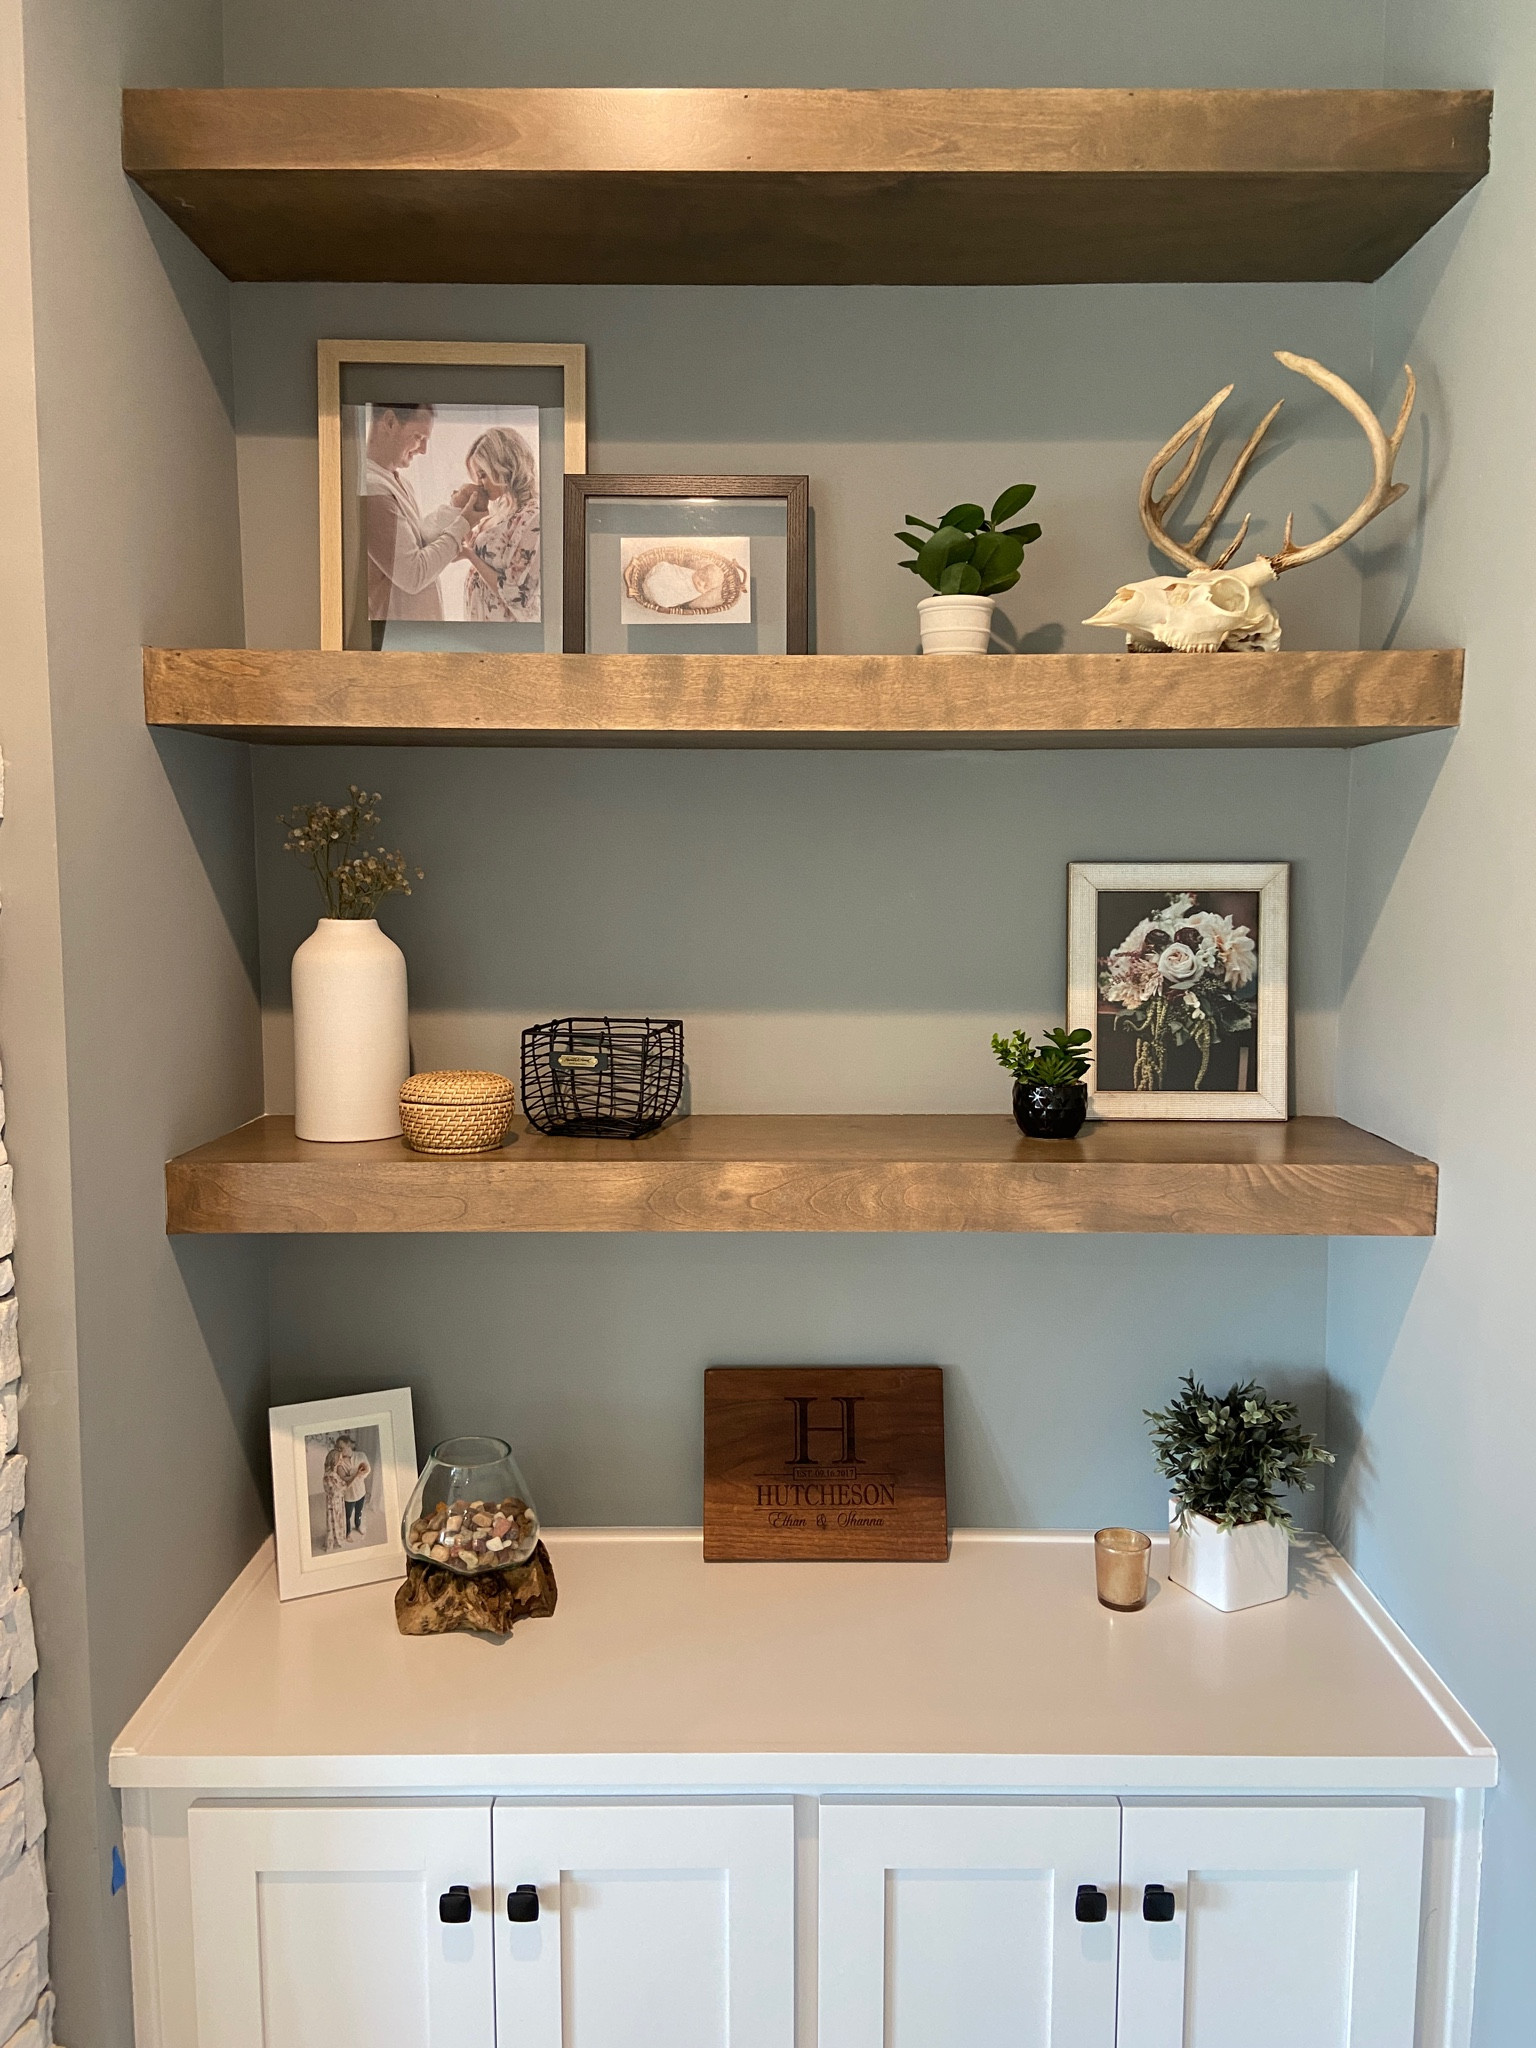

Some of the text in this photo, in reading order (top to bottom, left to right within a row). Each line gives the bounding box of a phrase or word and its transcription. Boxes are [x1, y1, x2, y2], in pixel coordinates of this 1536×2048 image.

[784, 1396, 866, 1464] H
[756, 1483, 895, 1506] HUTCHESON
[768, 1510, 885, 1529] Ethan & Shanna
